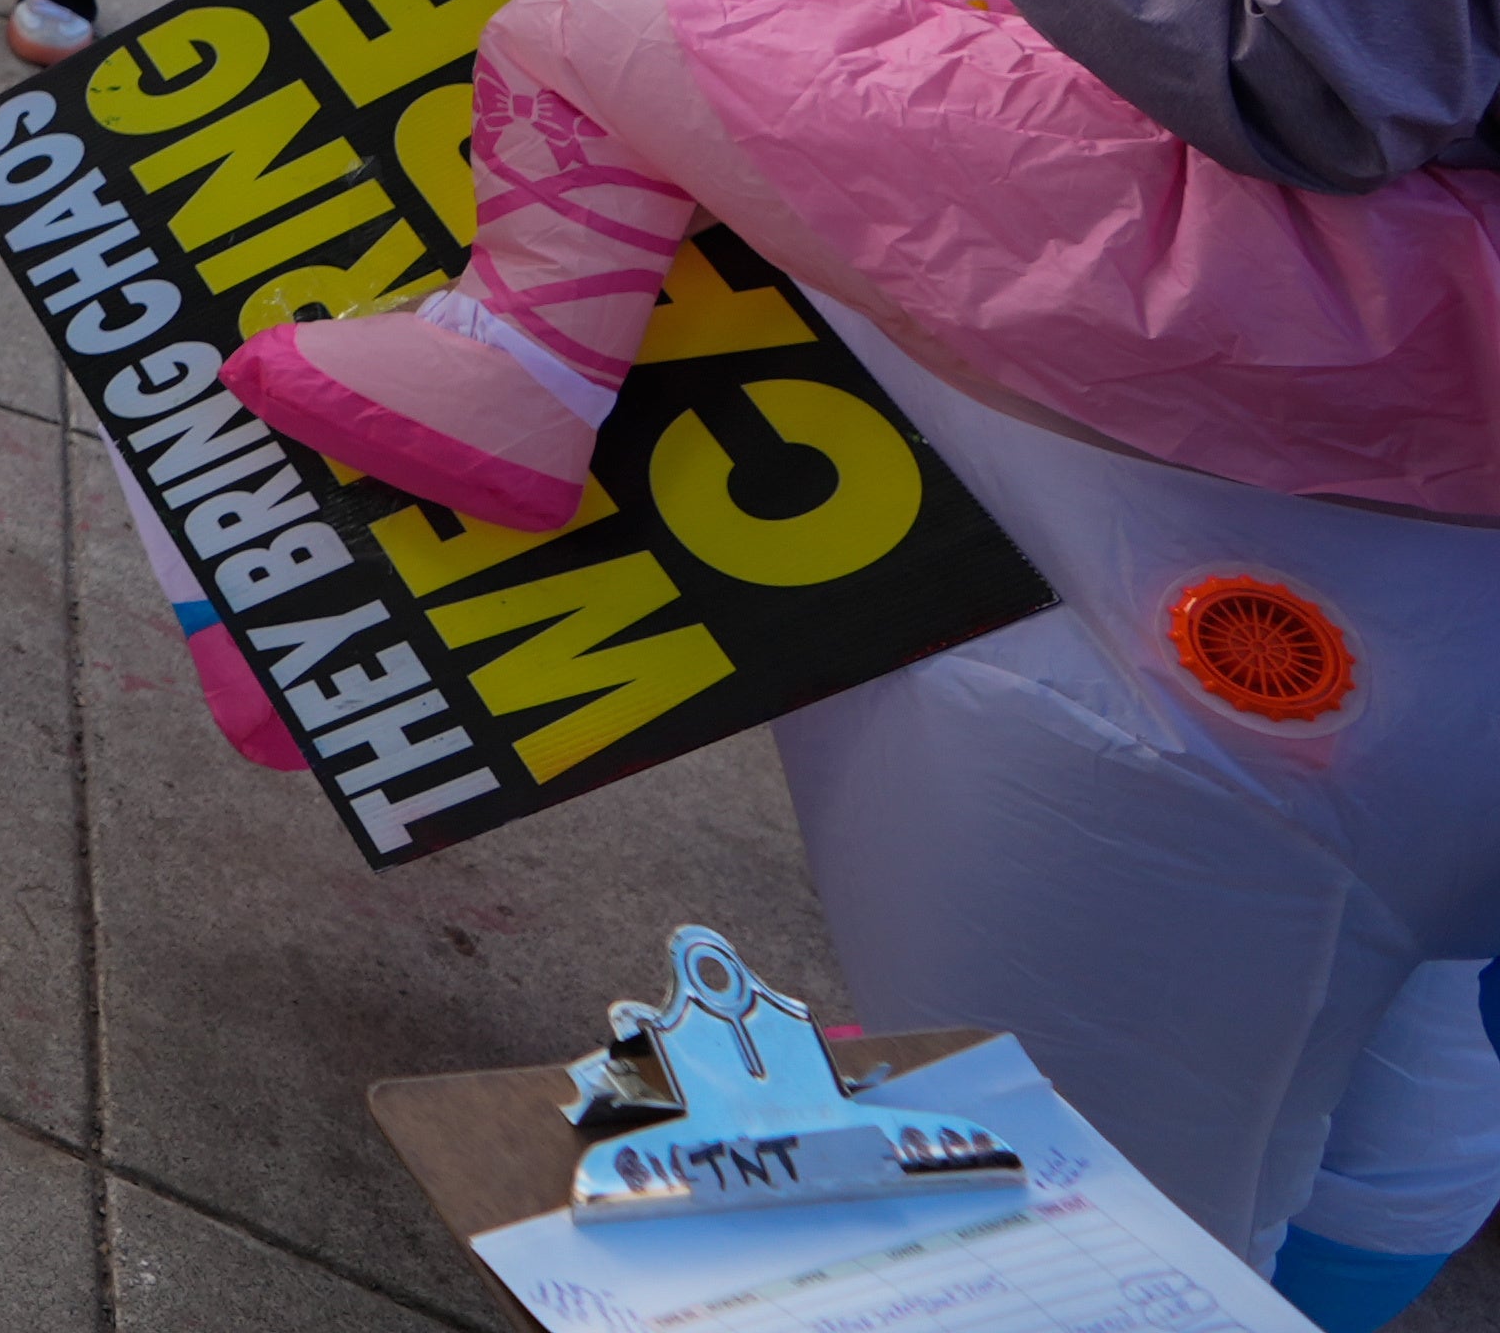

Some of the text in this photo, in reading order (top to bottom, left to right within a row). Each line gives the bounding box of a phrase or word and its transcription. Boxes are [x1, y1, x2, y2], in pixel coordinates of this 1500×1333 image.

[86, 6, 449, 481] RING
[104, 341, 352, 610] BRING
[247, 600, 498, 852] THEY
[688, 1134, 799, 1191] TNT
